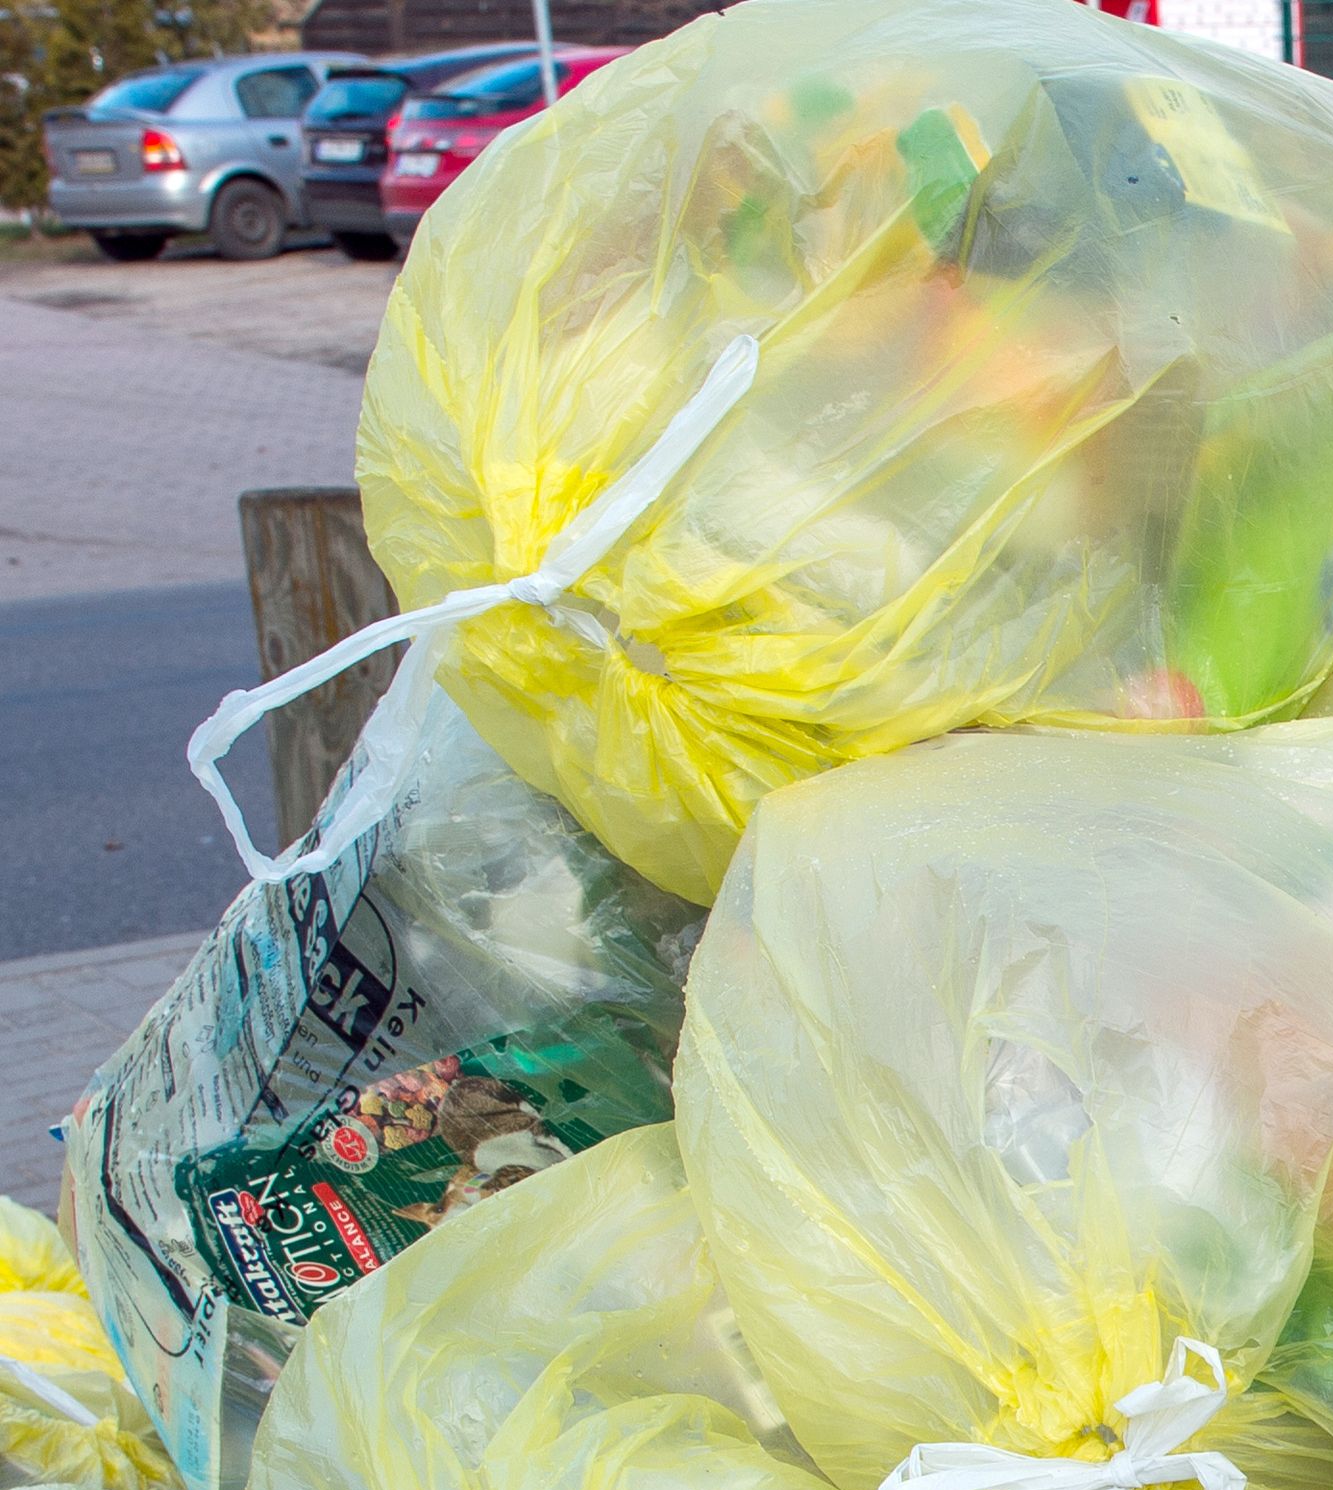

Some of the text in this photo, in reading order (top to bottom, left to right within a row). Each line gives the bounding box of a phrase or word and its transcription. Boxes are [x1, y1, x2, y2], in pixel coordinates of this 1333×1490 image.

[363, 986, 427, 1072] Kein
[215, 1200, 298, 1322] itakraft
[329, 1198, 378, 1273] ALANCE
